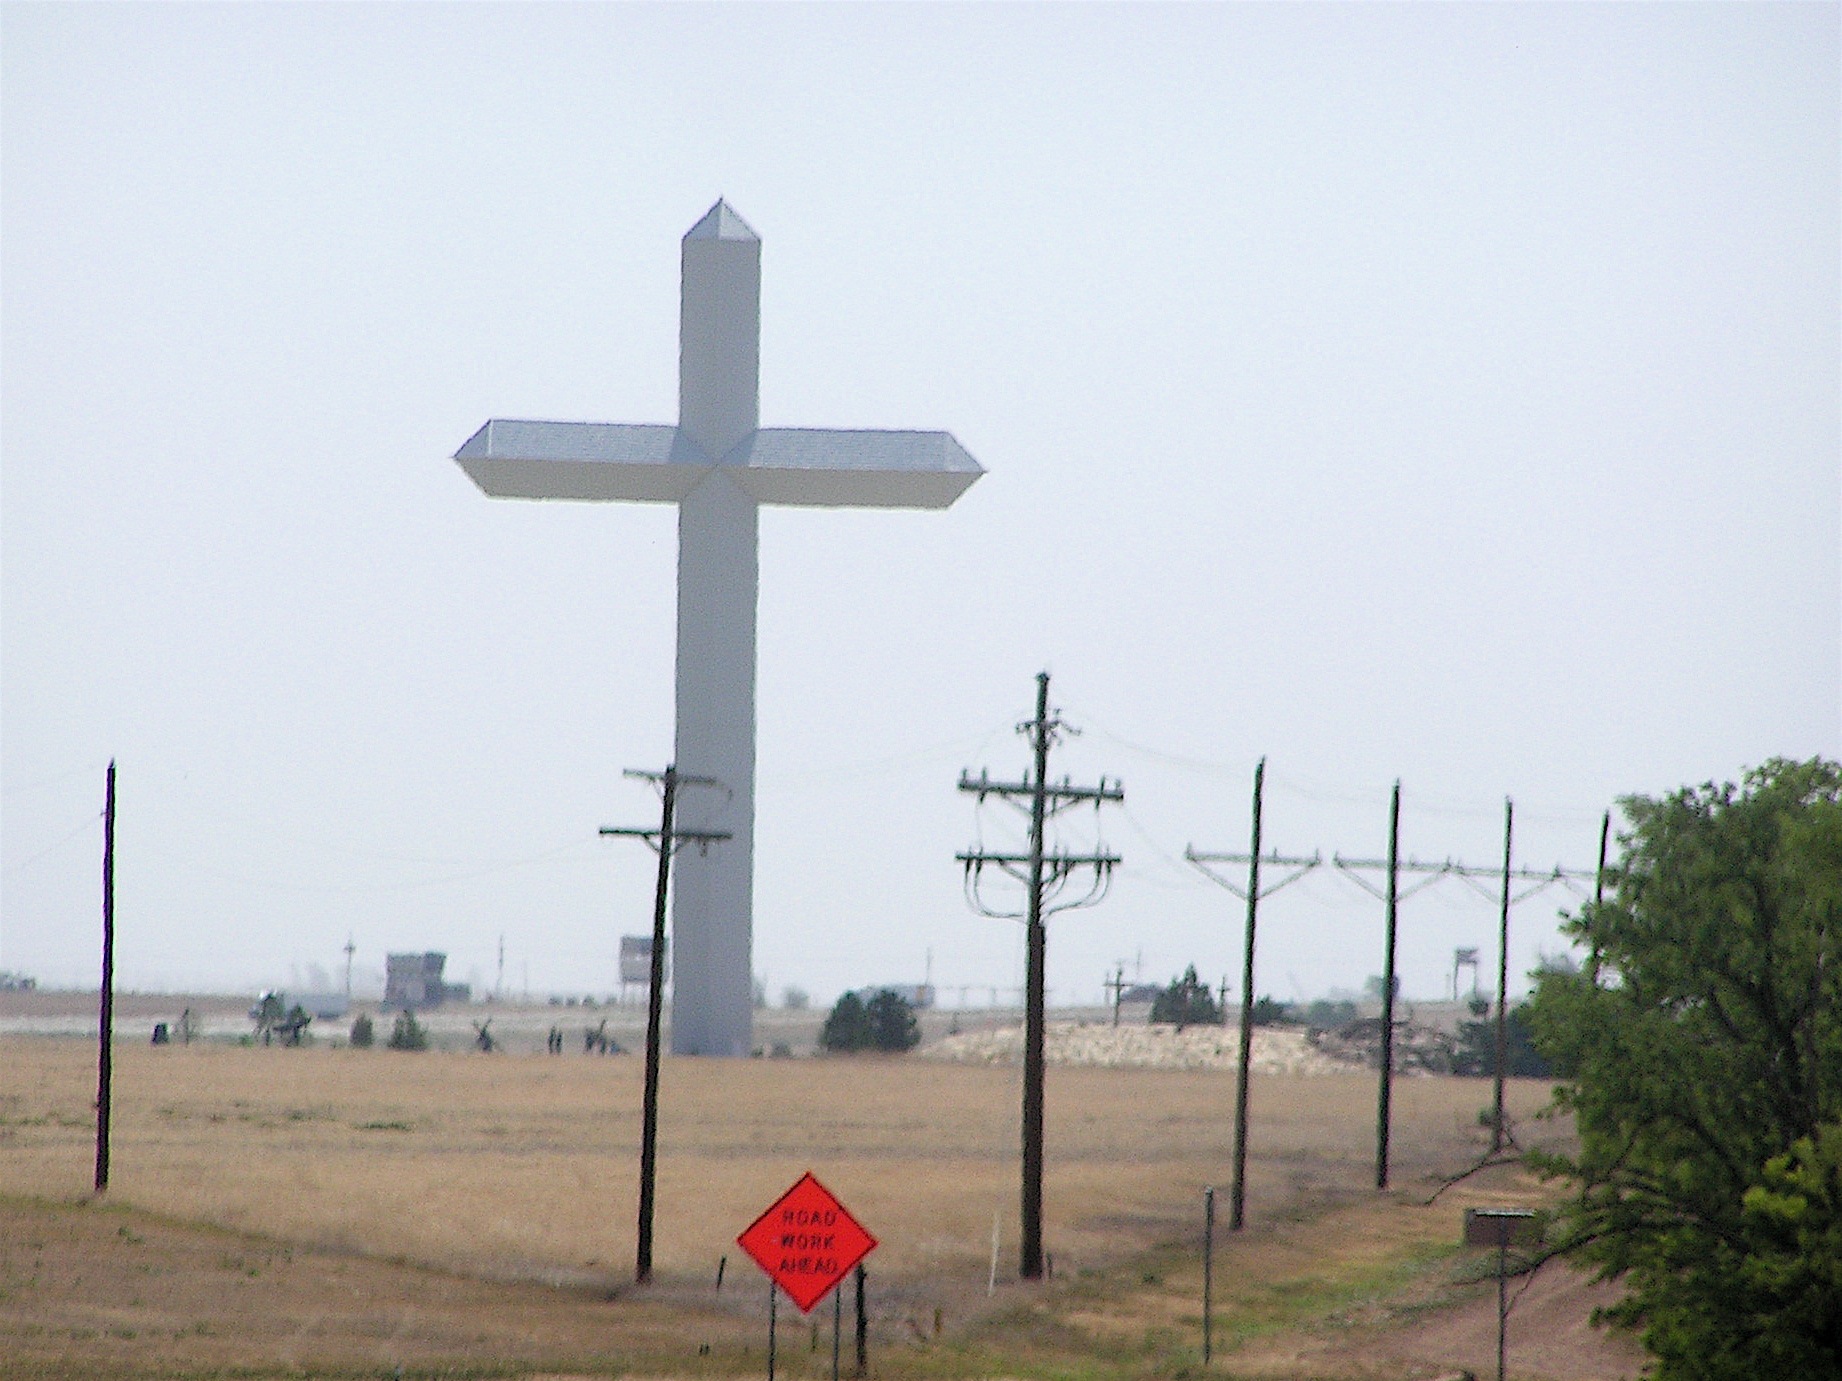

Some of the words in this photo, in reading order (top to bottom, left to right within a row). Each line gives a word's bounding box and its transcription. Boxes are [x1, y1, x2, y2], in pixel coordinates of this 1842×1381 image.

[782, 1209, 837, 1226] ROAD
[780, 1233, 835, 1250] WORK
[779, 1257, 838, 1275] AHEAD
